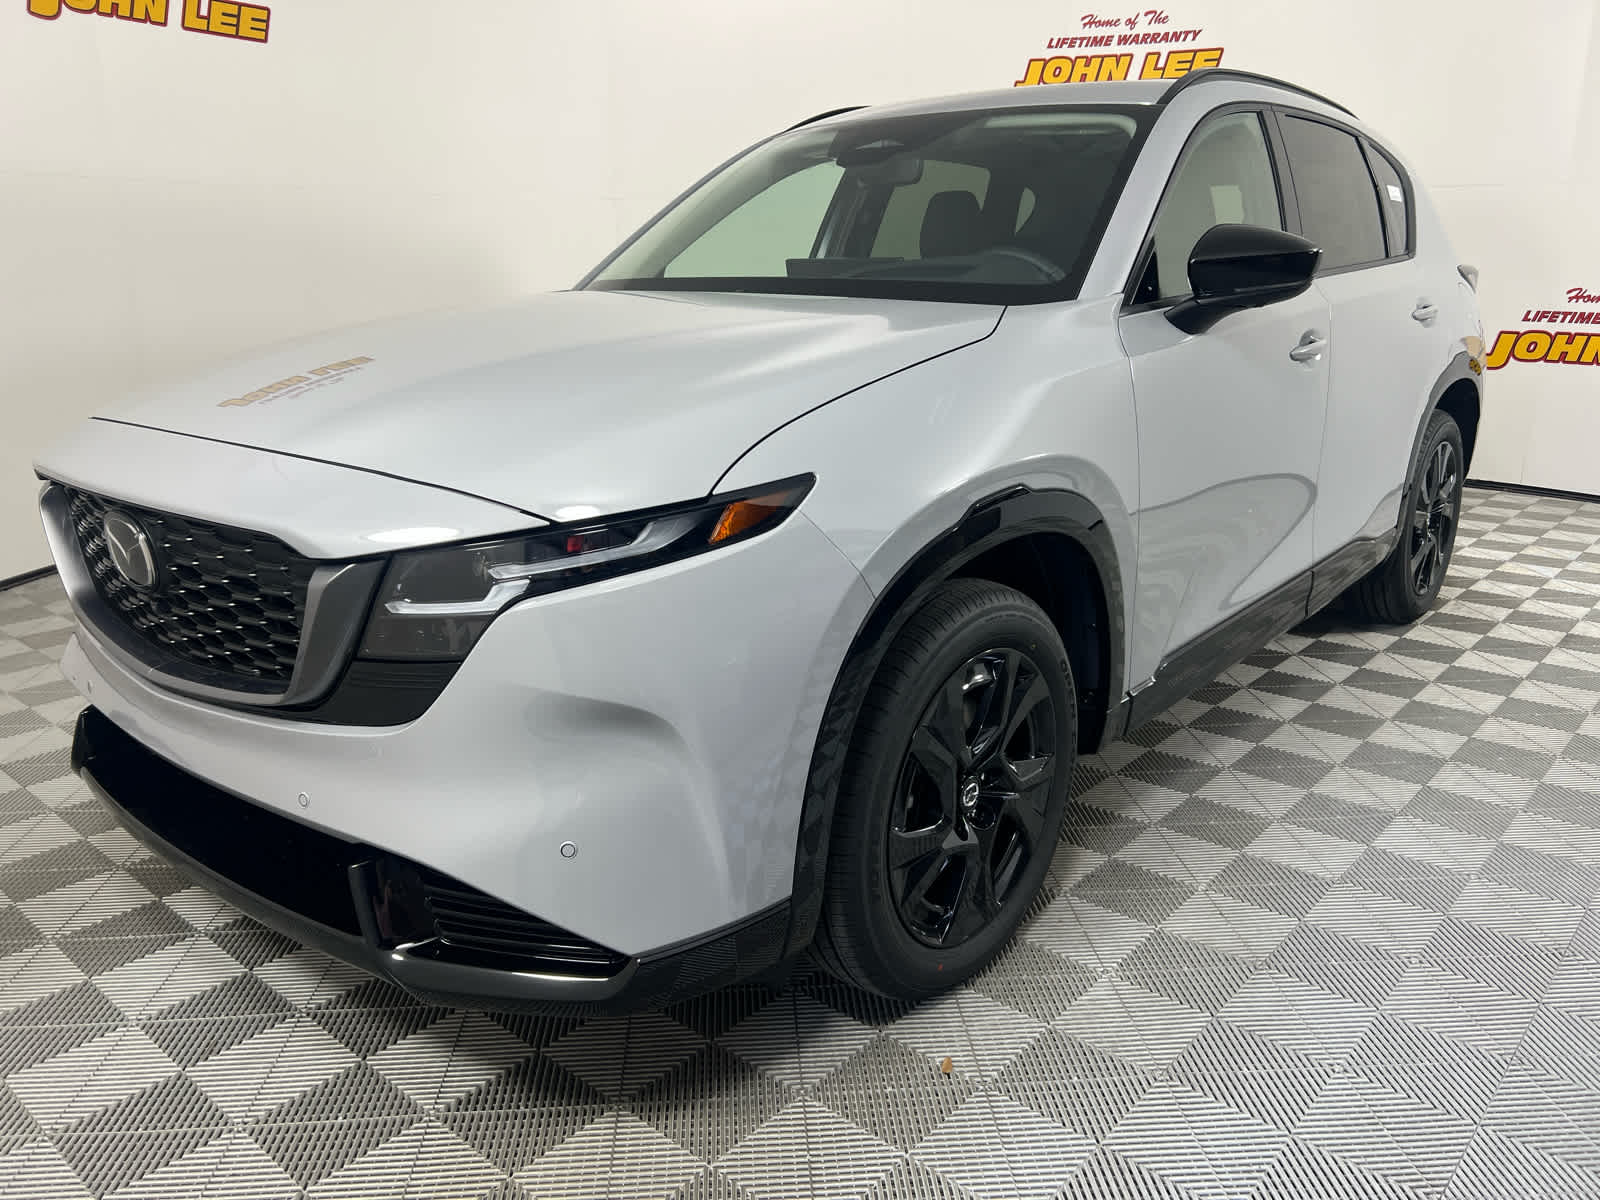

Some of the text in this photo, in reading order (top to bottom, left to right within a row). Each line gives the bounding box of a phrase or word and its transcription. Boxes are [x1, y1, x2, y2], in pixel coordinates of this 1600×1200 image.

[182, 0, 270, 43] LEE
[1081, 9, 1170, 31] Home of The
[1047, 29, 1202, 49] LIFETIME WARRANTY
[1014, 53, 1134, 87] JOHN
